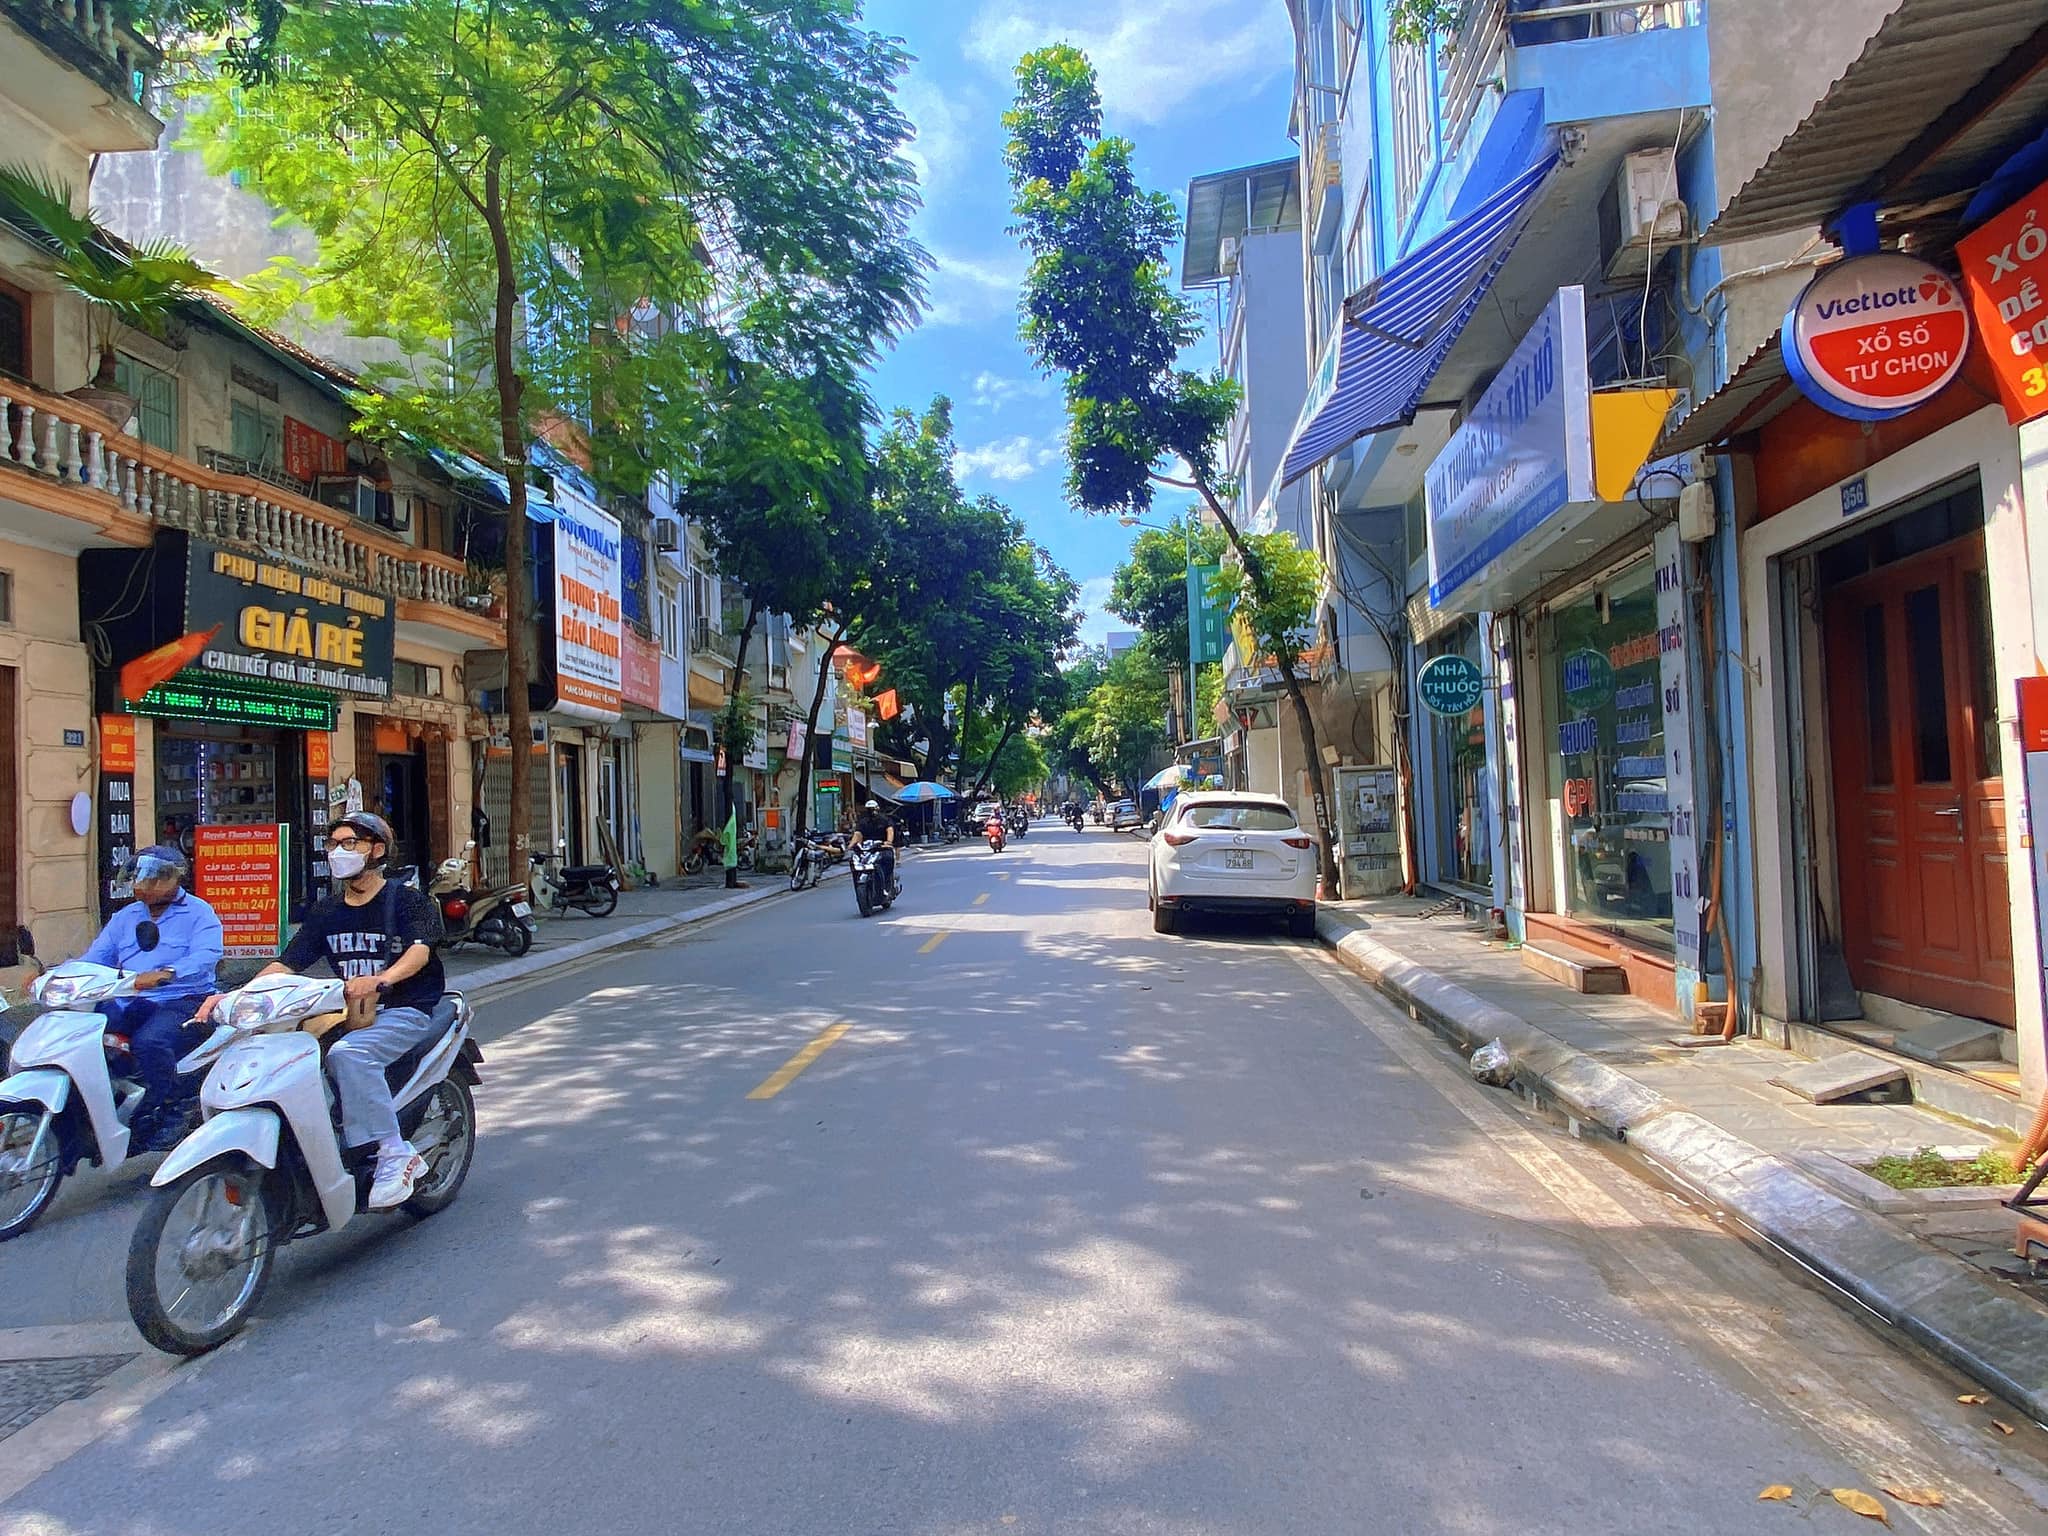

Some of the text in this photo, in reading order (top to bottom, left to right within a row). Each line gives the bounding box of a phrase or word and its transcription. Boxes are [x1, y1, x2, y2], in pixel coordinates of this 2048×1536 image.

[1986, 208, 2047, 284] XỔ
[1816, 286, 1916, 320] Vietlott
[1998, 276, 2042, 324] DỄ
[1857, 321, 1930, 355] XỔ SỐ
[1885, 351, 1948, 374] CHỌN
[1431, 463, 1448, 521] NHÀ
[1448, 423, 1477, 505] THUỐC
[1479, 392, 1494, 466] SỐ
[1506, 364, 1529, 435] TÂY
[1533, 315, 1553, 408] HỒ
[1498, 458, 1518, 493] GPP
[213, 551, 257, 586] PHỤ
[257, 564, 300, 594] KIỆN
[1655, 553, 1678, 594] NHÀ
[560, 573, 619, 623] TRUNG TÂM
[240, 606, 364, 668] GIÁ RẺ
[562, 609, 587, 646] BẢO
[589, 623, 619, 658] HÀNH
[1656, 610, 1682, 653] THUỐC
[202, 650, 240, 672] CAM
[240, 653, 269, 677] KẾT
[270, 660, 296, 682] GIÁ
[297, 662, 316, 683] RẺ
[318, 668, 350, 690] NHẤT
[350, 674, 367, 693] HÀ
[1424, 676, 1480, 694] THUỐC
[1433, 660, 1468, 676] NHÀ
[1665, 674, 1680, 713] SỐ
[1558, 708, 1598, 755] THUỐC
[109, 781, 130, 801] MUA
[111, 811, 130, 834] BÁN
[255, 843, 277, 858] THOẠI
[206, 887, 236, 896] SIM
[251, 898, 276, 911] 24/7
